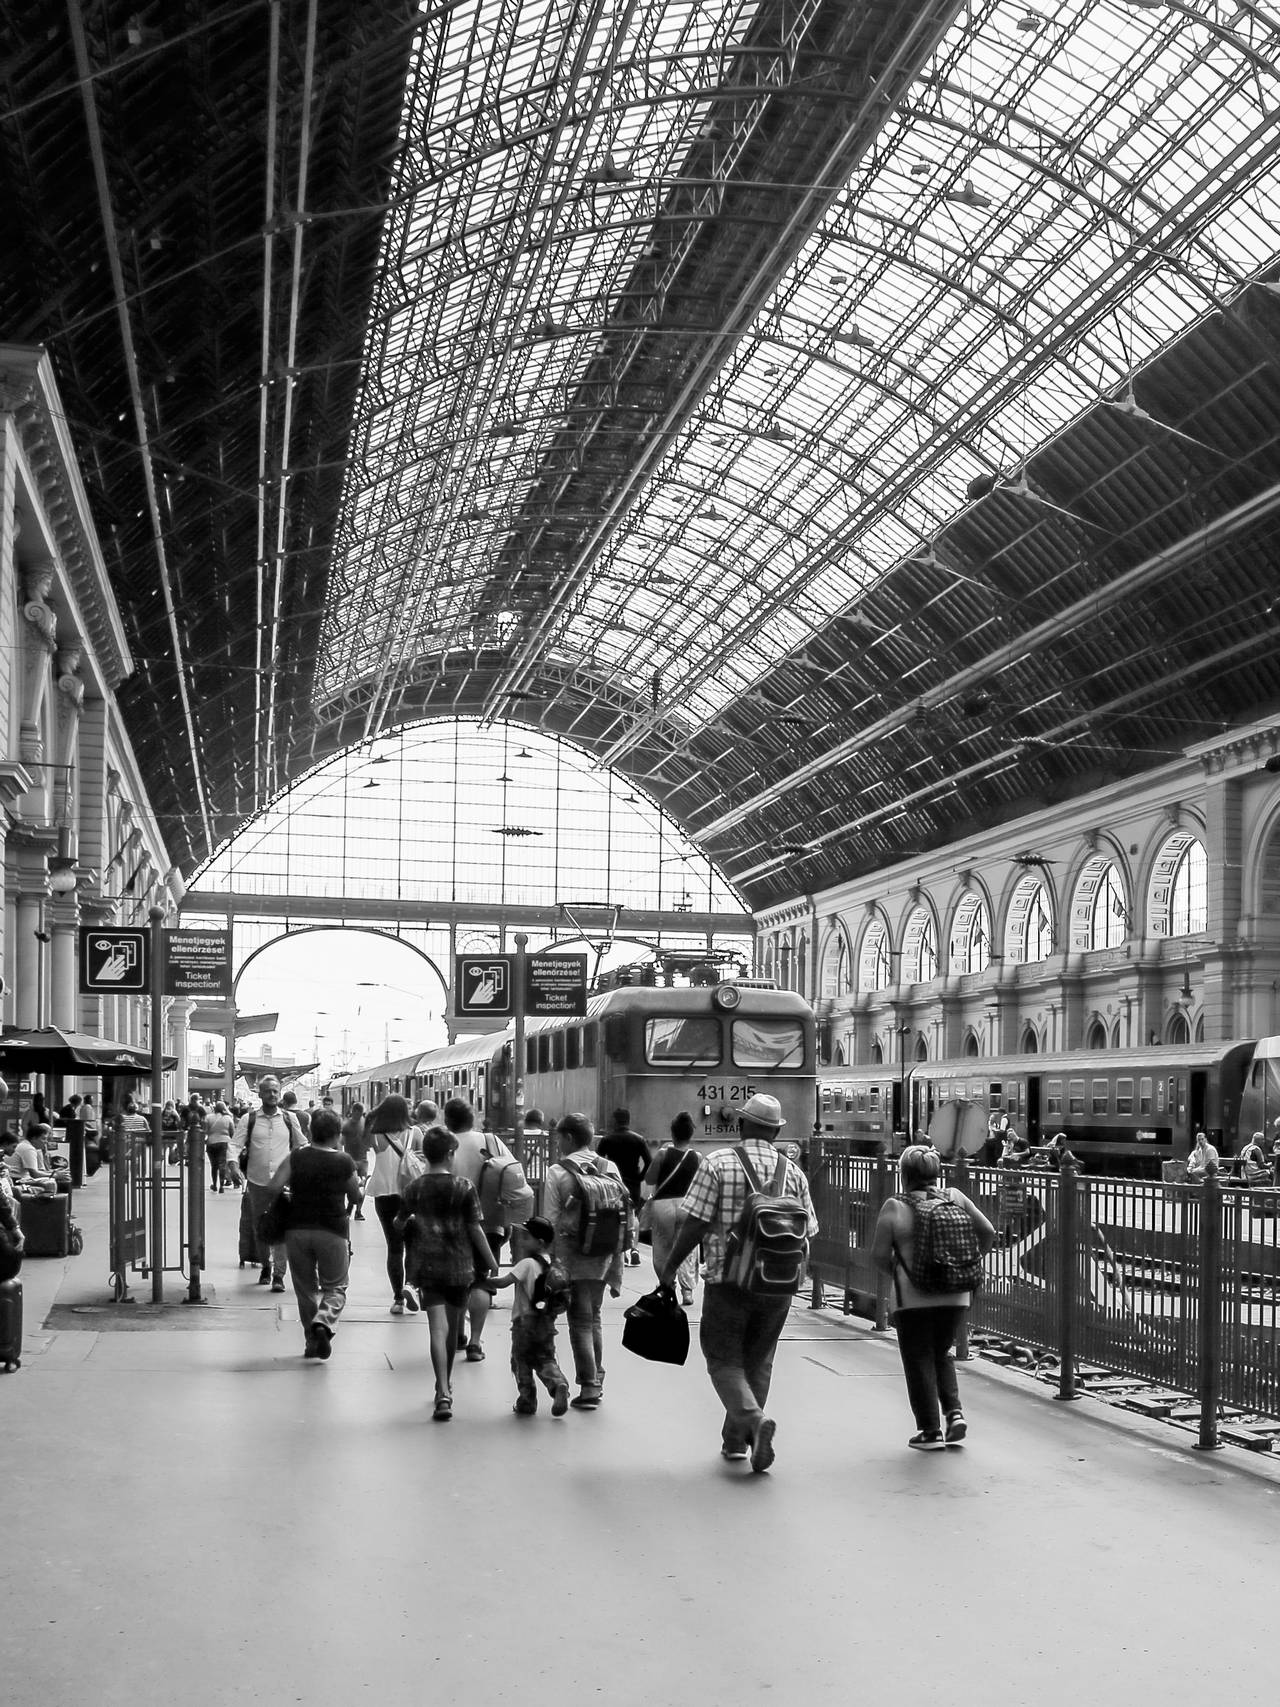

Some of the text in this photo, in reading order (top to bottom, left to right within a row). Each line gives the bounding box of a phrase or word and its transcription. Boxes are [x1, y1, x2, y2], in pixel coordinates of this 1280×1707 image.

[169, 936, 226, 946] Menetjegyek
[531, 960, 581, 970] Menetjegyek
[185, 971, 211, 980] Ticket
[175, 980, 221, 989] inspection!
[544, 993, 568, 1001] Ticket
[536, 1001, 576, 1010] inspection!
[697, 1085, 756, 1100] 431 215
